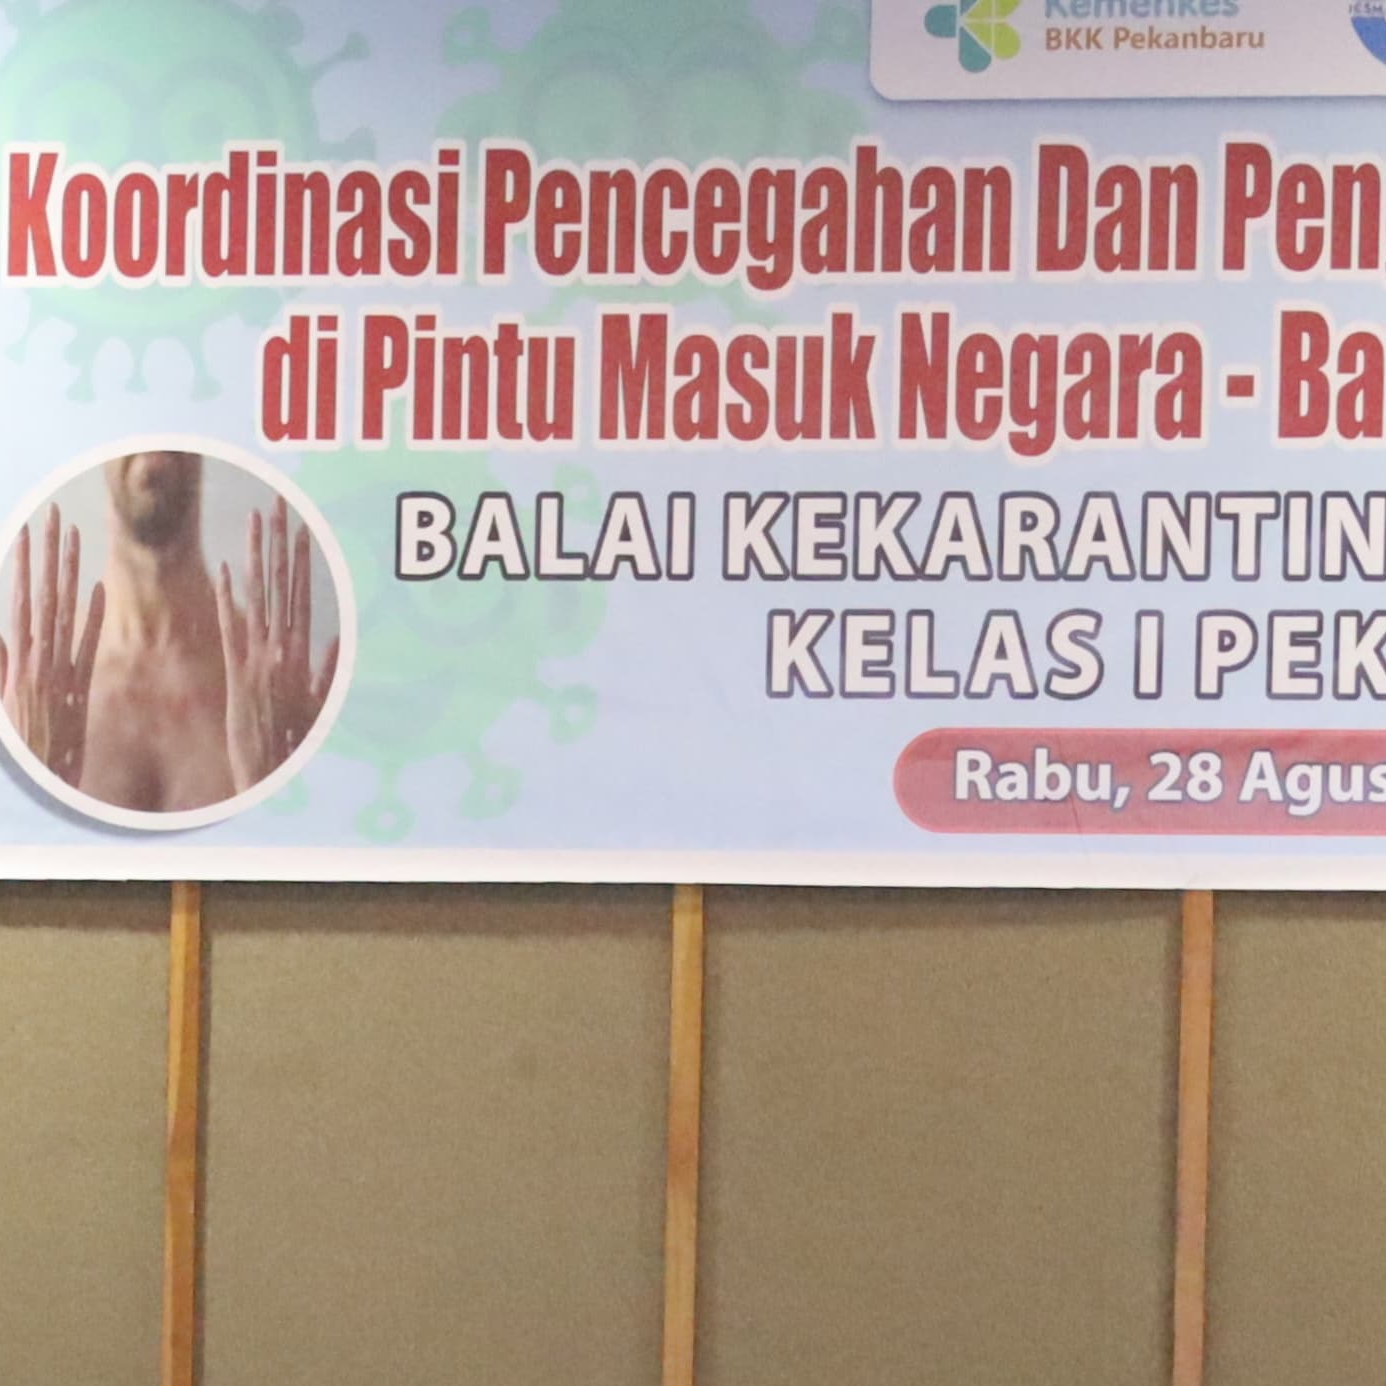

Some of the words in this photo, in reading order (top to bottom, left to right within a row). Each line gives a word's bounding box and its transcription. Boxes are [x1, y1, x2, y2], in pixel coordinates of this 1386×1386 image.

[1045, 27, 1103, 51] BKK
[1113, 25, 1265, 51] Pekanbaru
[8, 150, 459, 279] Koordinasi
[484, 146, 1010, 291] Pencegahan
[1037, 144, 1197, 273] Dan
[262, 314, 338, 441] di
[362, 314, 574, 441] Pintu
[600, 313, 876, 441] Masuk
[899, 313, 1203, 456] Negara
[1227, 375, 1254, 398] -
[395, 491, 696, 582] BALAI
[767, 609, 1104, 701] KELAS
[1134, 610, 1164, 700] I
[954, 748, 1130, 809] Rabu,
[1147, 750, 1223, 803] 28
